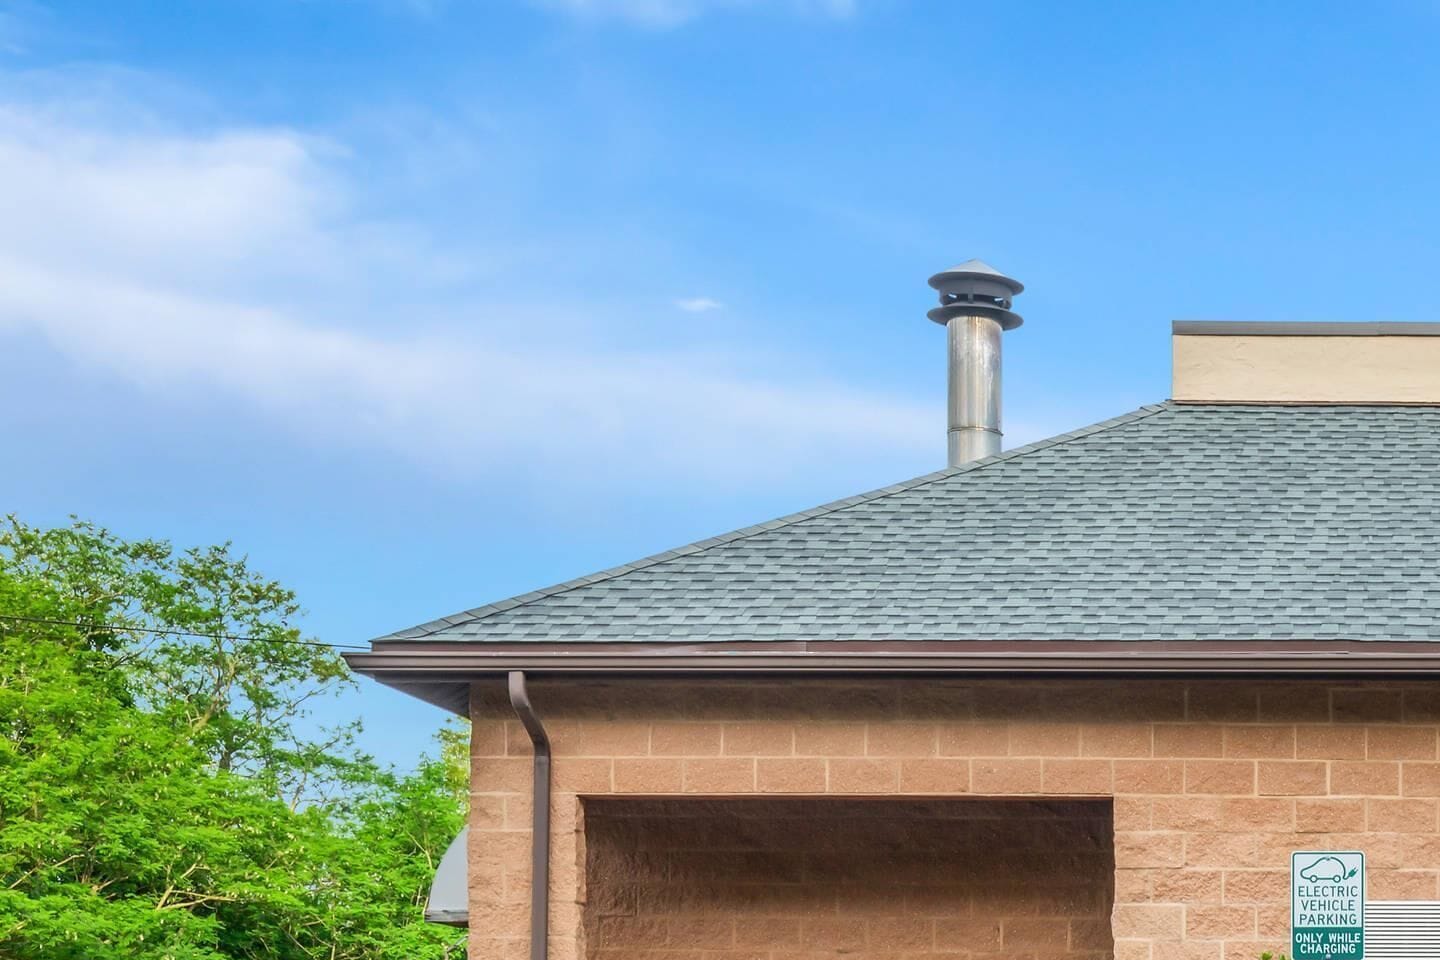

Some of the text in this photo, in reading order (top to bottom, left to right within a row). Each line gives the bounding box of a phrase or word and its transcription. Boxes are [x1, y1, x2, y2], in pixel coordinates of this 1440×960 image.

[1298, 885, 1358, 897] ELECTRIC
[1301, 899, 1356, 911] VEHICLE
[1299, 913, 1357, 925] PARKING
[1295, 932, 1361, 943] ONLY WHILE
[1300, 943, 1356, 954] CHARGING
